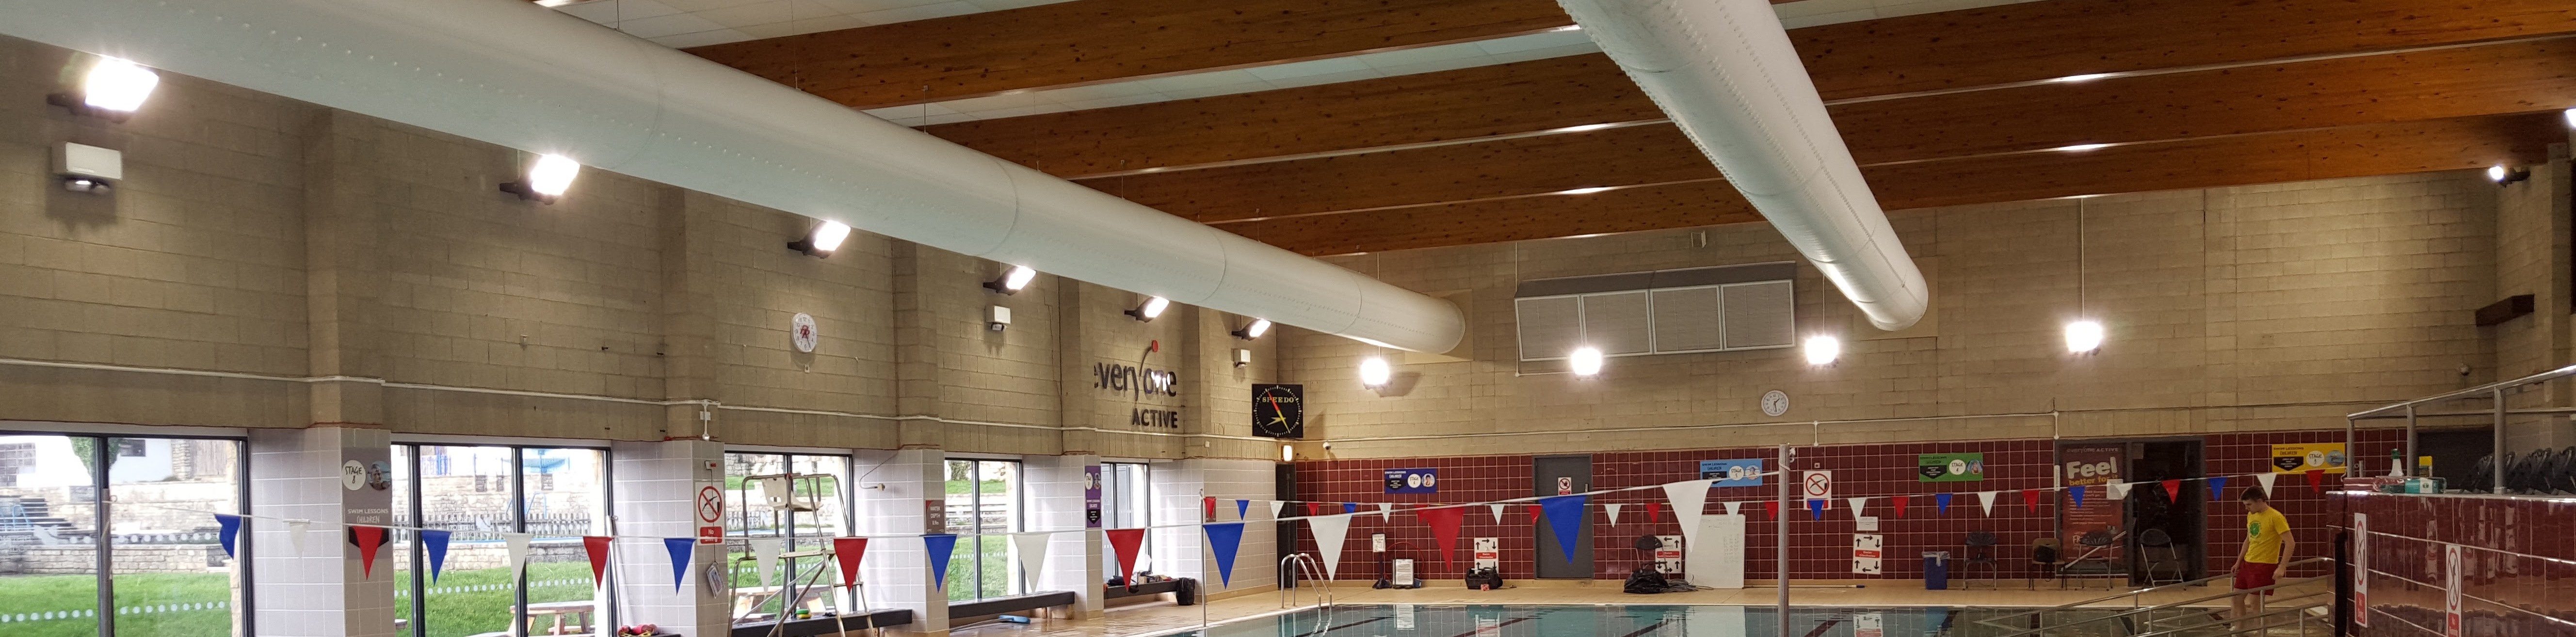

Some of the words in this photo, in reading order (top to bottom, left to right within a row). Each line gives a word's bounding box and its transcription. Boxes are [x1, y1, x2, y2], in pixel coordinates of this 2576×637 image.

[1132, 408, 1177, 428] ACTIVE
[345, 466, 362, 475] STAGE
[2066, 457, 2117, 479] Feel
[352, 476, 355, 484] 8
[357, 515, 380, 524] CHILDREN
